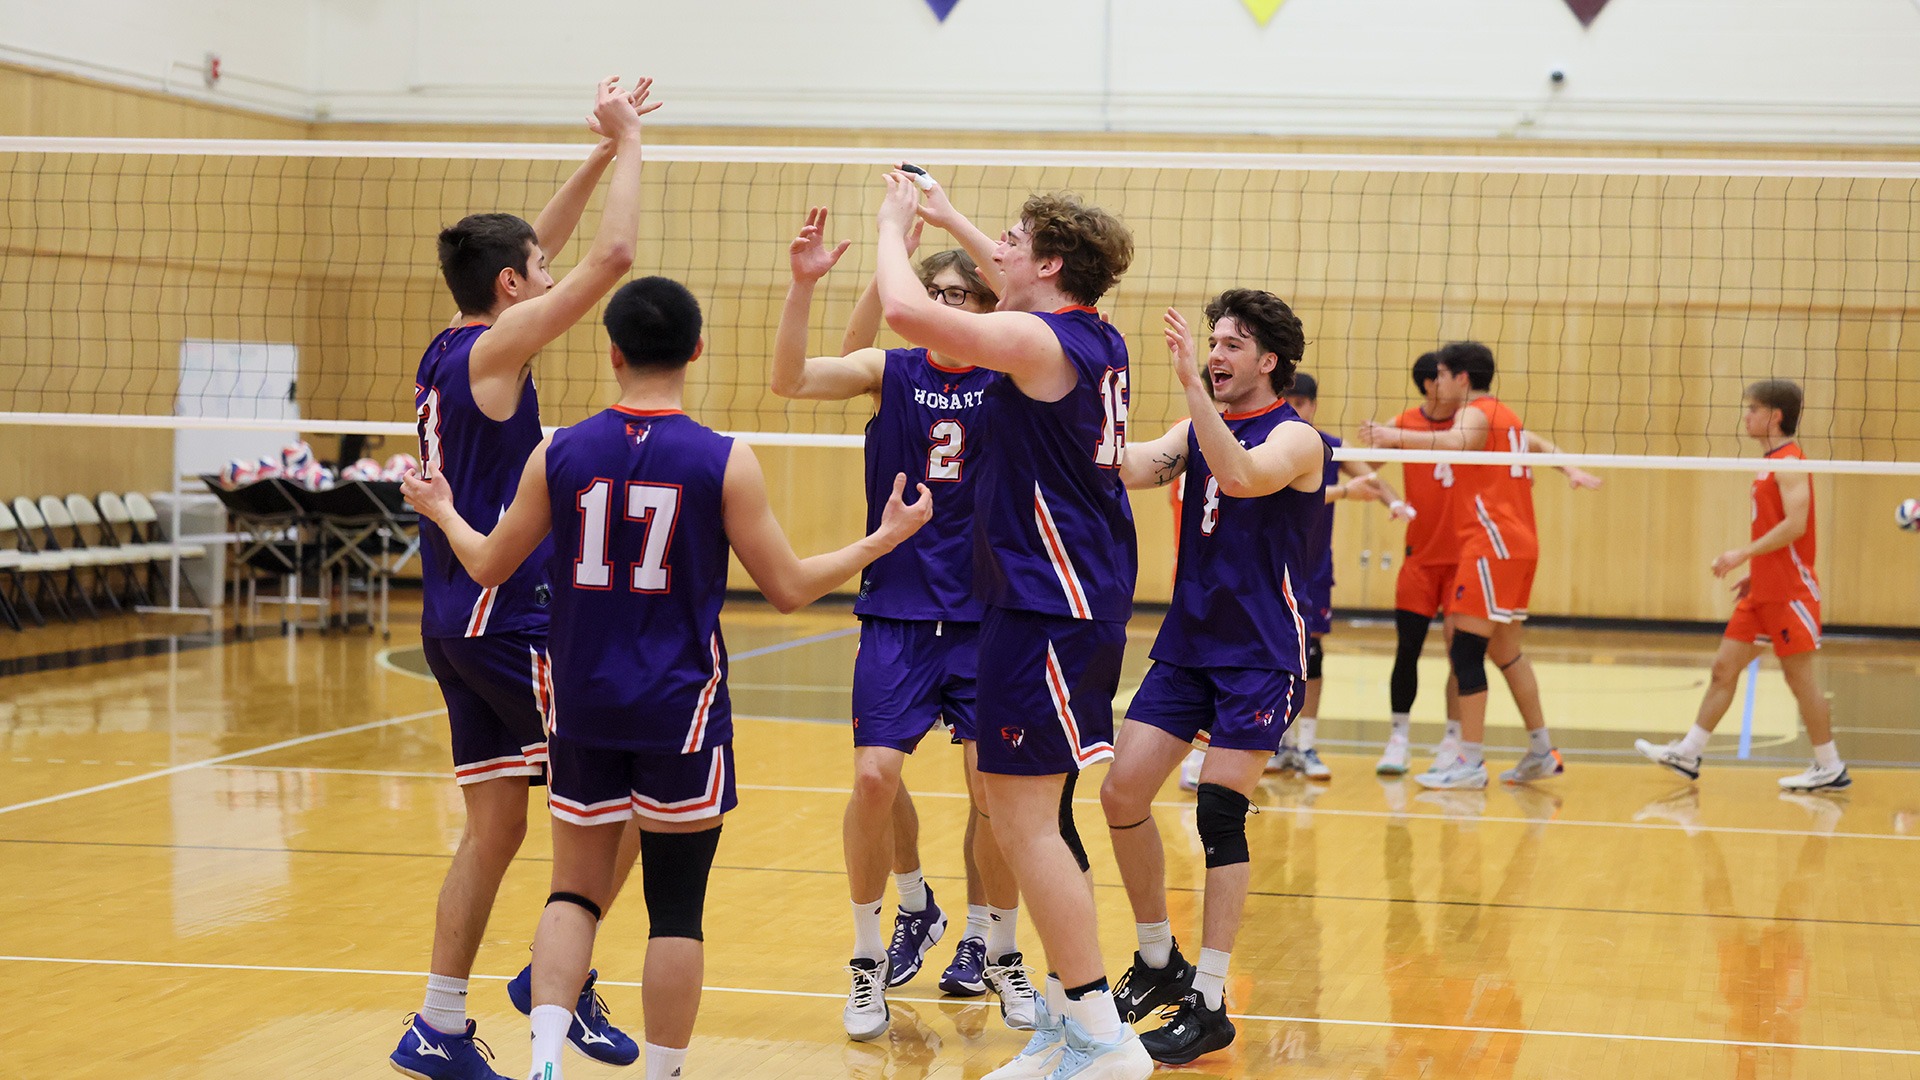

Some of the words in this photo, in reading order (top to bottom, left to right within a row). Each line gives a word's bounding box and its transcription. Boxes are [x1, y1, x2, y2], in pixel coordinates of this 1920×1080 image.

[914, 387, 984, 410] HOBART
[1092, 365, 1128, 469] 15
[926, 418, 966, 482] 2
[573, 477, 683, 594] 17
